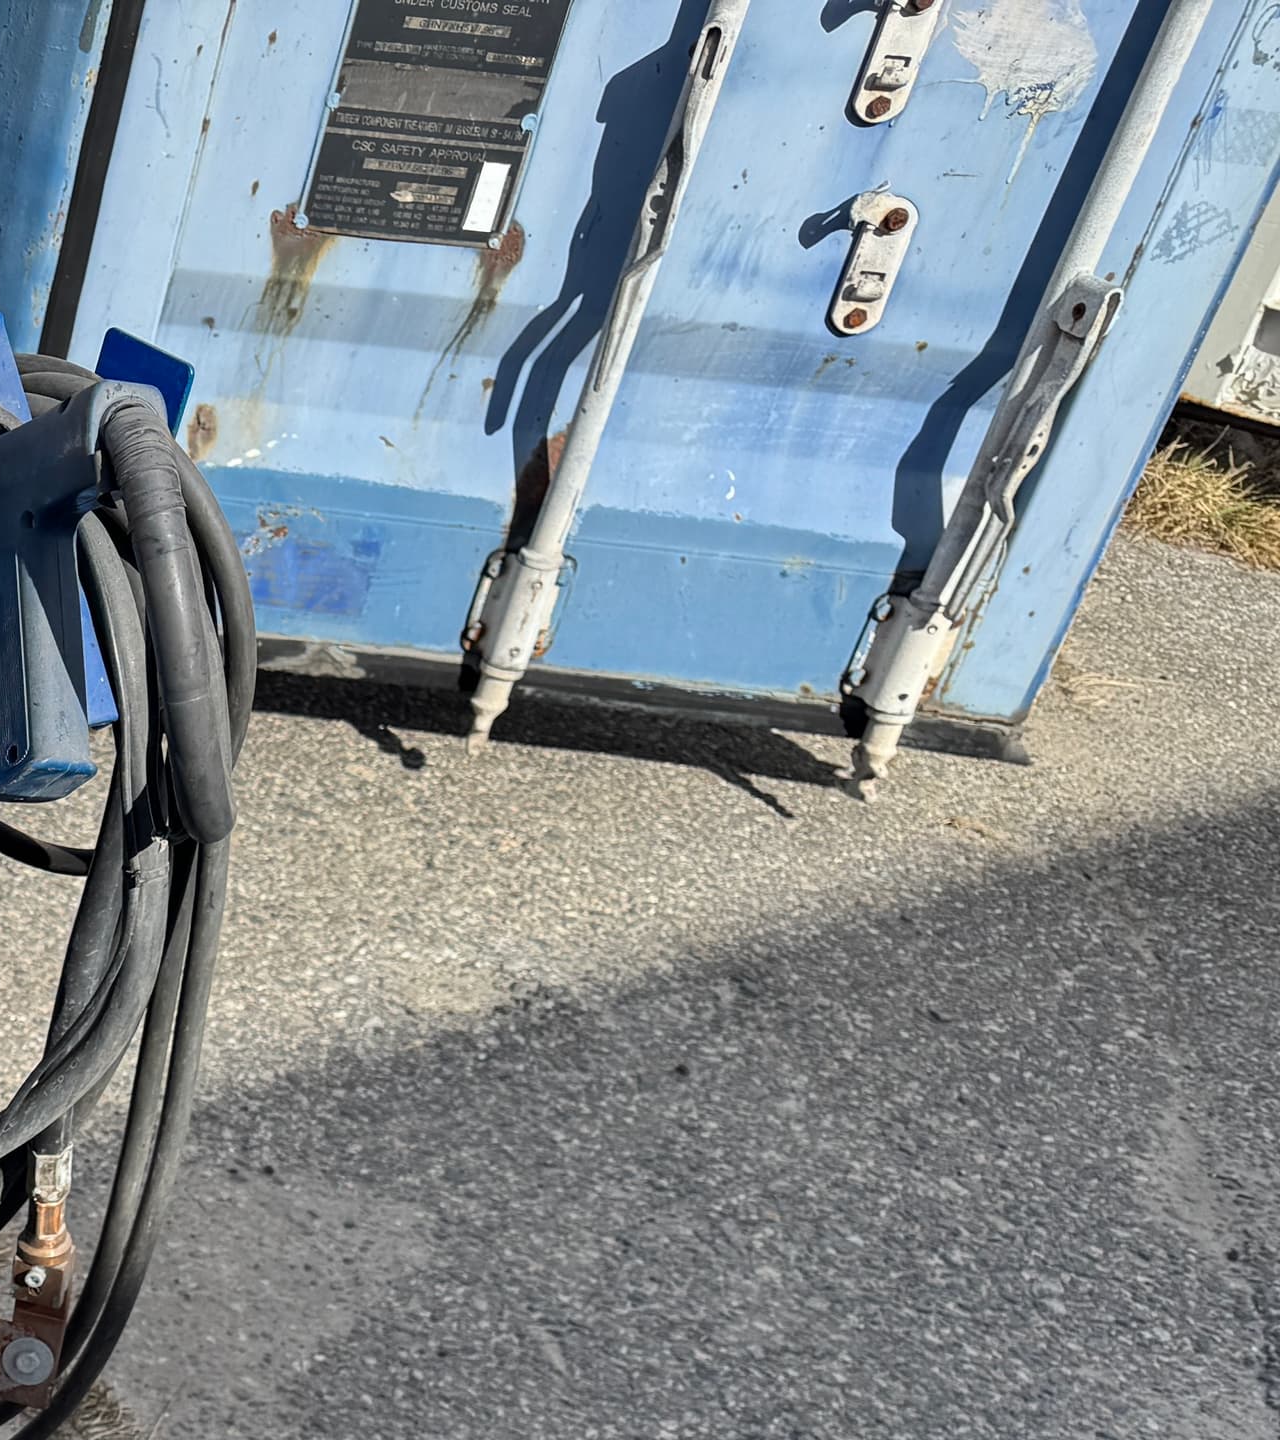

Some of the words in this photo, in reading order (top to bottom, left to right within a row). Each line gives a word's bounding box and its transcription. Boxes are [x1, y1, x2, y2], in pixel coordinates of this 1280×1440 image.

[441, 0, 498, 14] CUSTOMS
[502, 4, 532, 18] SEAL
[352, 139, 377, 152] CSC
[381, 143, 426, 157] SAFETY
[429, 148, 487, 162] APPROVAL
